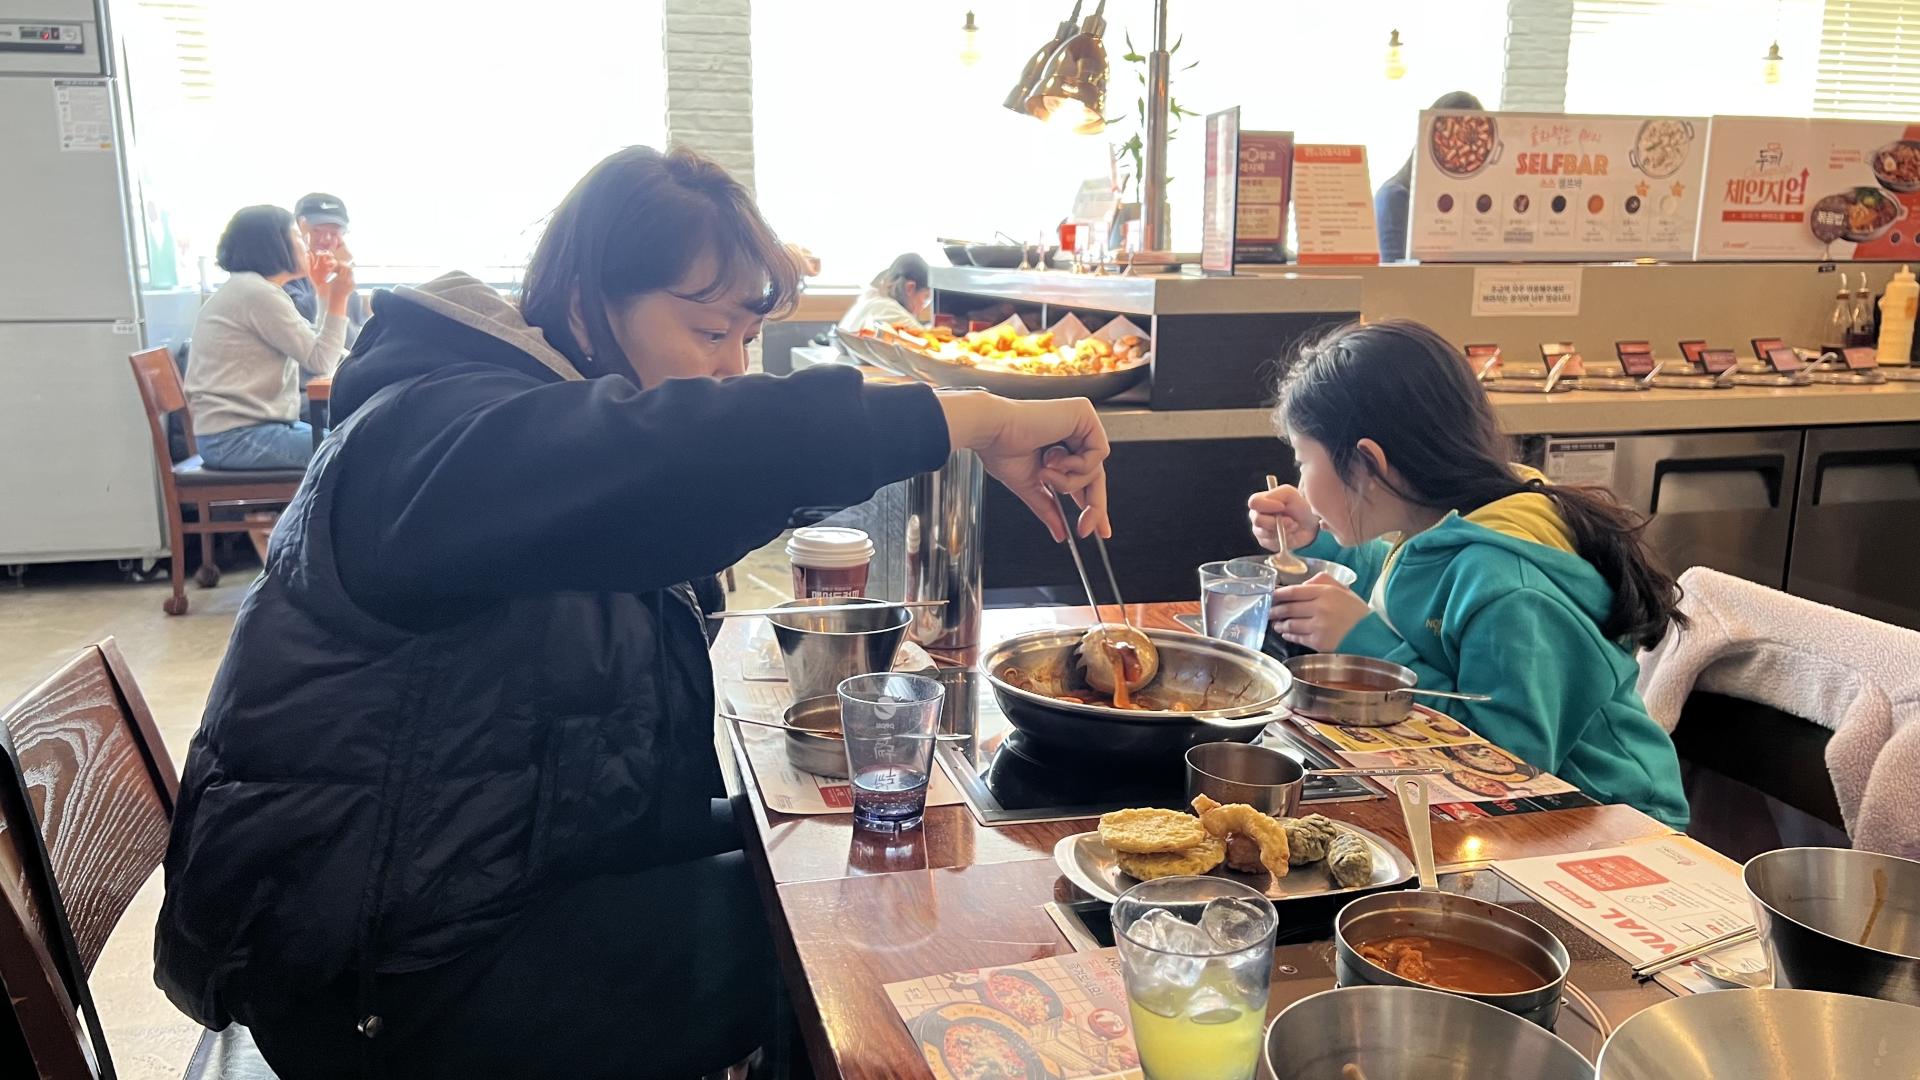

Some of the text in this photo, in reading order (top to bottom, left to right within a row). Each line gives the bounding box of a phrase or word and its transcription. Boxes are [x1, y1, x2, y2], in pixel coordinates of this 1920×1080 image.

[1516, 152, 1609, 175] SELFBAR
[1756, 149, 1784, 172] 두끼
[1723, 175, 1807, 206] 체인지업
